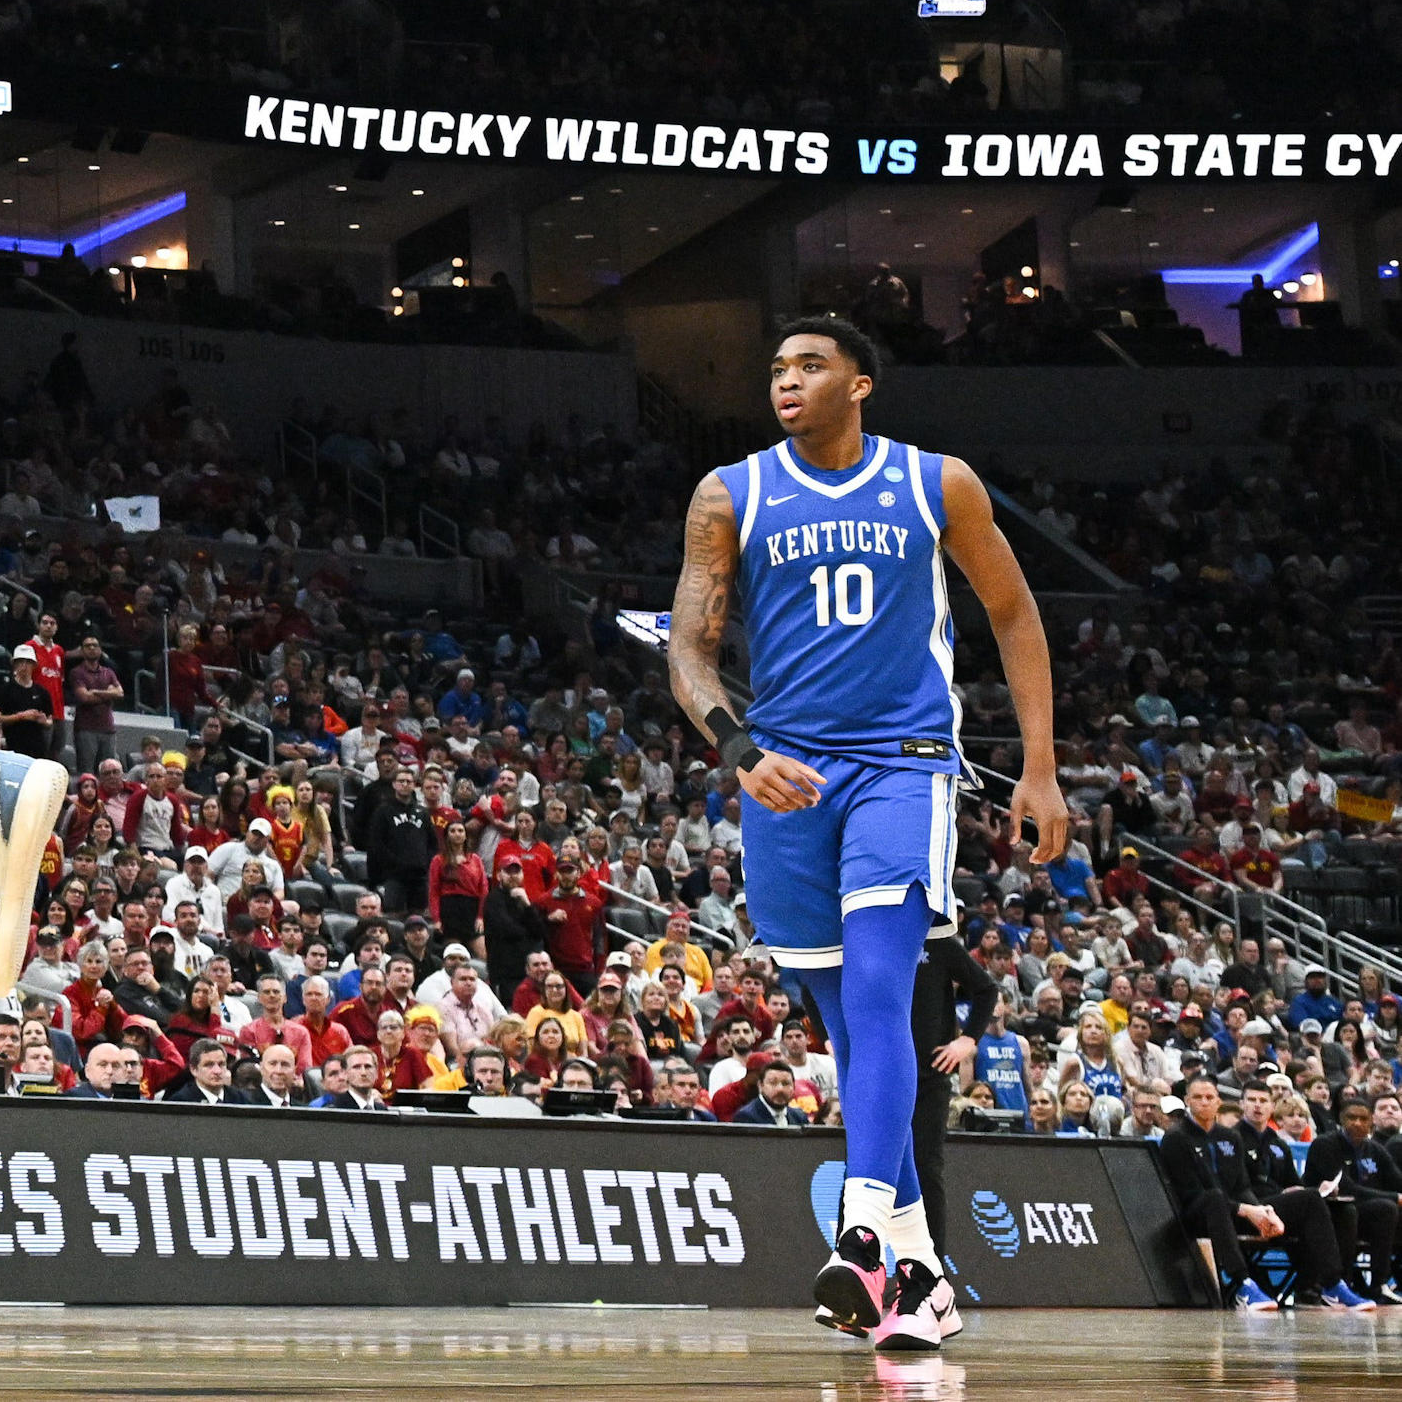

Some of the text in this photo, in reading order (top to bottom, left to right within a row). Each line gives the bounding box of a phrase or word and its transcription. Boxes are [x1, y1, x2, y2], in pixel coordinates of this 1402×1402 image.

[244, 94, 1402, 177] KENTUCKY WILDCATS VS IOWA STATE CY
[766, 520, 909, 566] KENTUCKY
[809, 563, 874, 627] 10
[986, 1046, 1016, 1060] BLUE
[986, 1069, 1021, 1083] BLOOD
[83, 1153, 746, 1264] STUDENT-ATHLETES
[1023, 1202, 1099, 1248] AT&T
